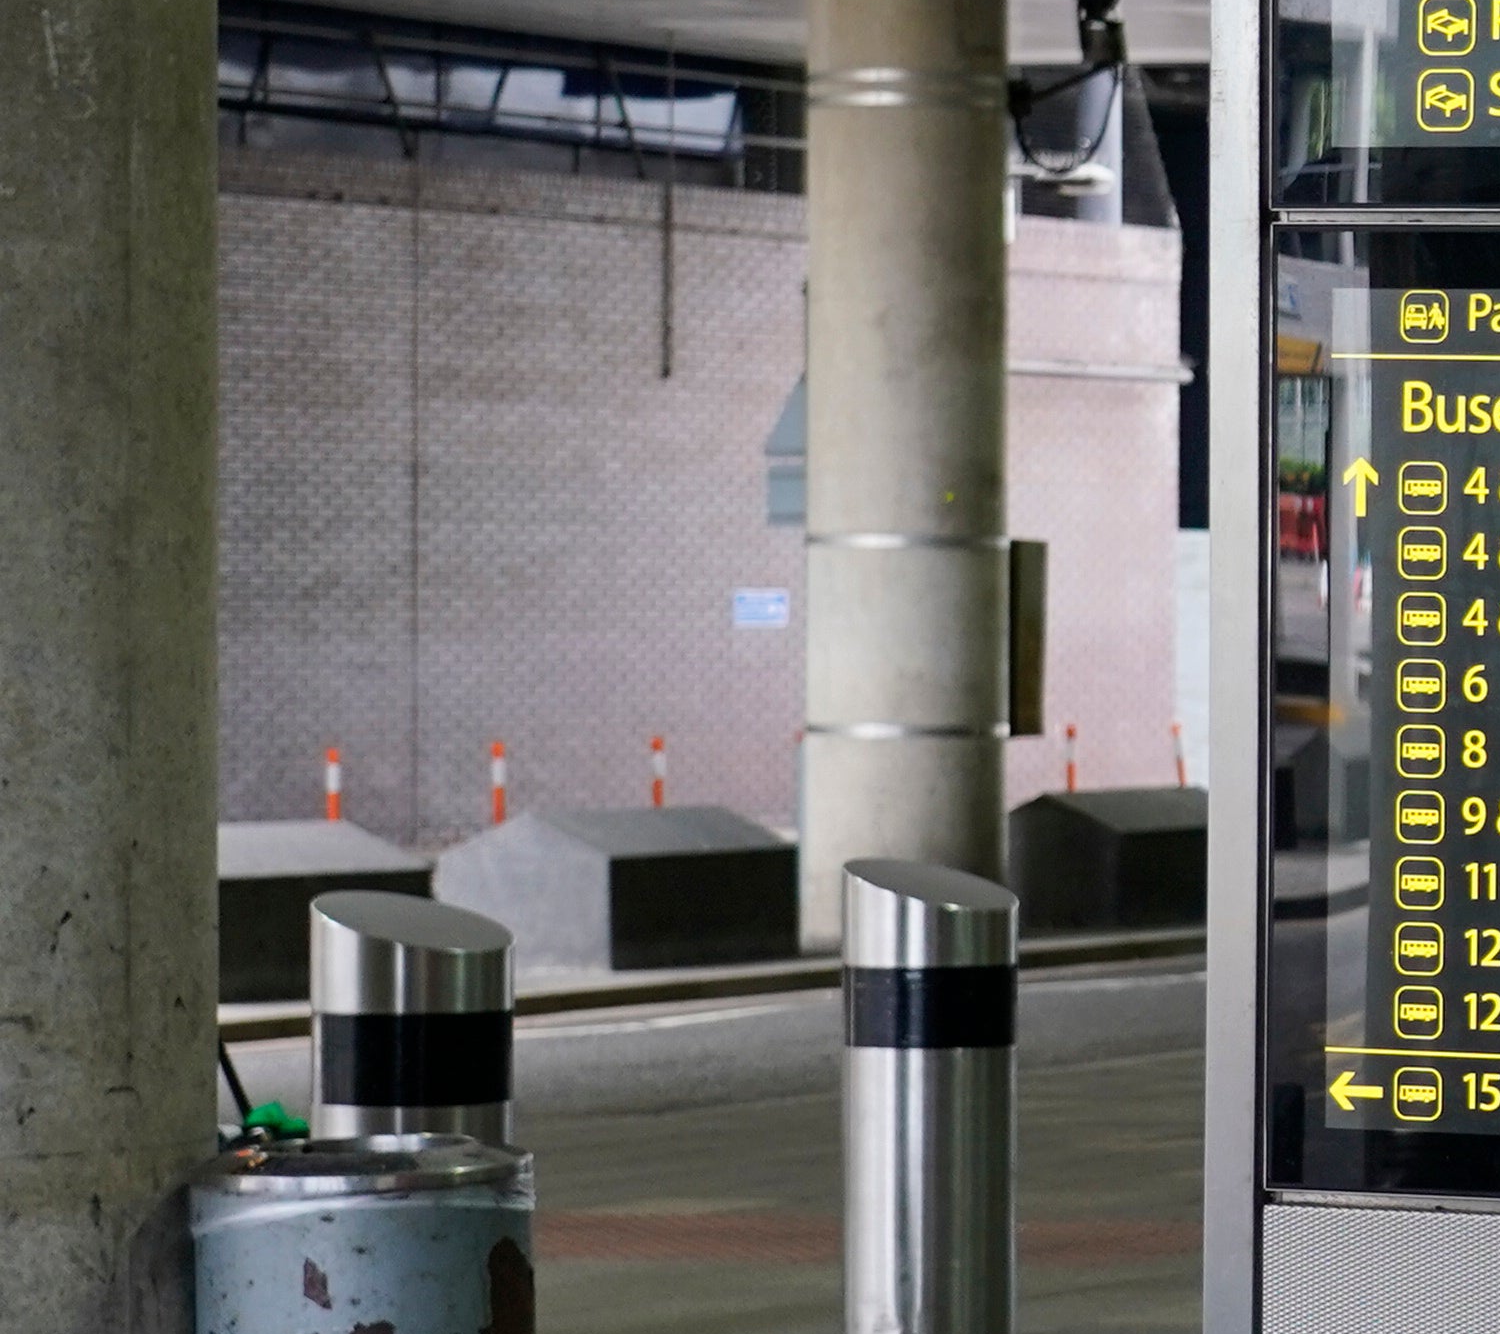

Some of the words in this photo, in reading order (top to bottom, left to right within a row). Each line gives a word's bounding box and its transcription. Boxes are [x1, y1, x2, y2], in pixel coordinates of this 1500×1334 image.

[1462, 466, 1489, 504] 4
[1461, 532, 1488, 568] 4
[1461, 599, 1488, 635] 4
[1461, 663, 1489, 703] 6
[1461, 729, 1487, 769] 8
[1461, 796, 1487, 836] 9
[1464, 862, 1497, 901] 11
